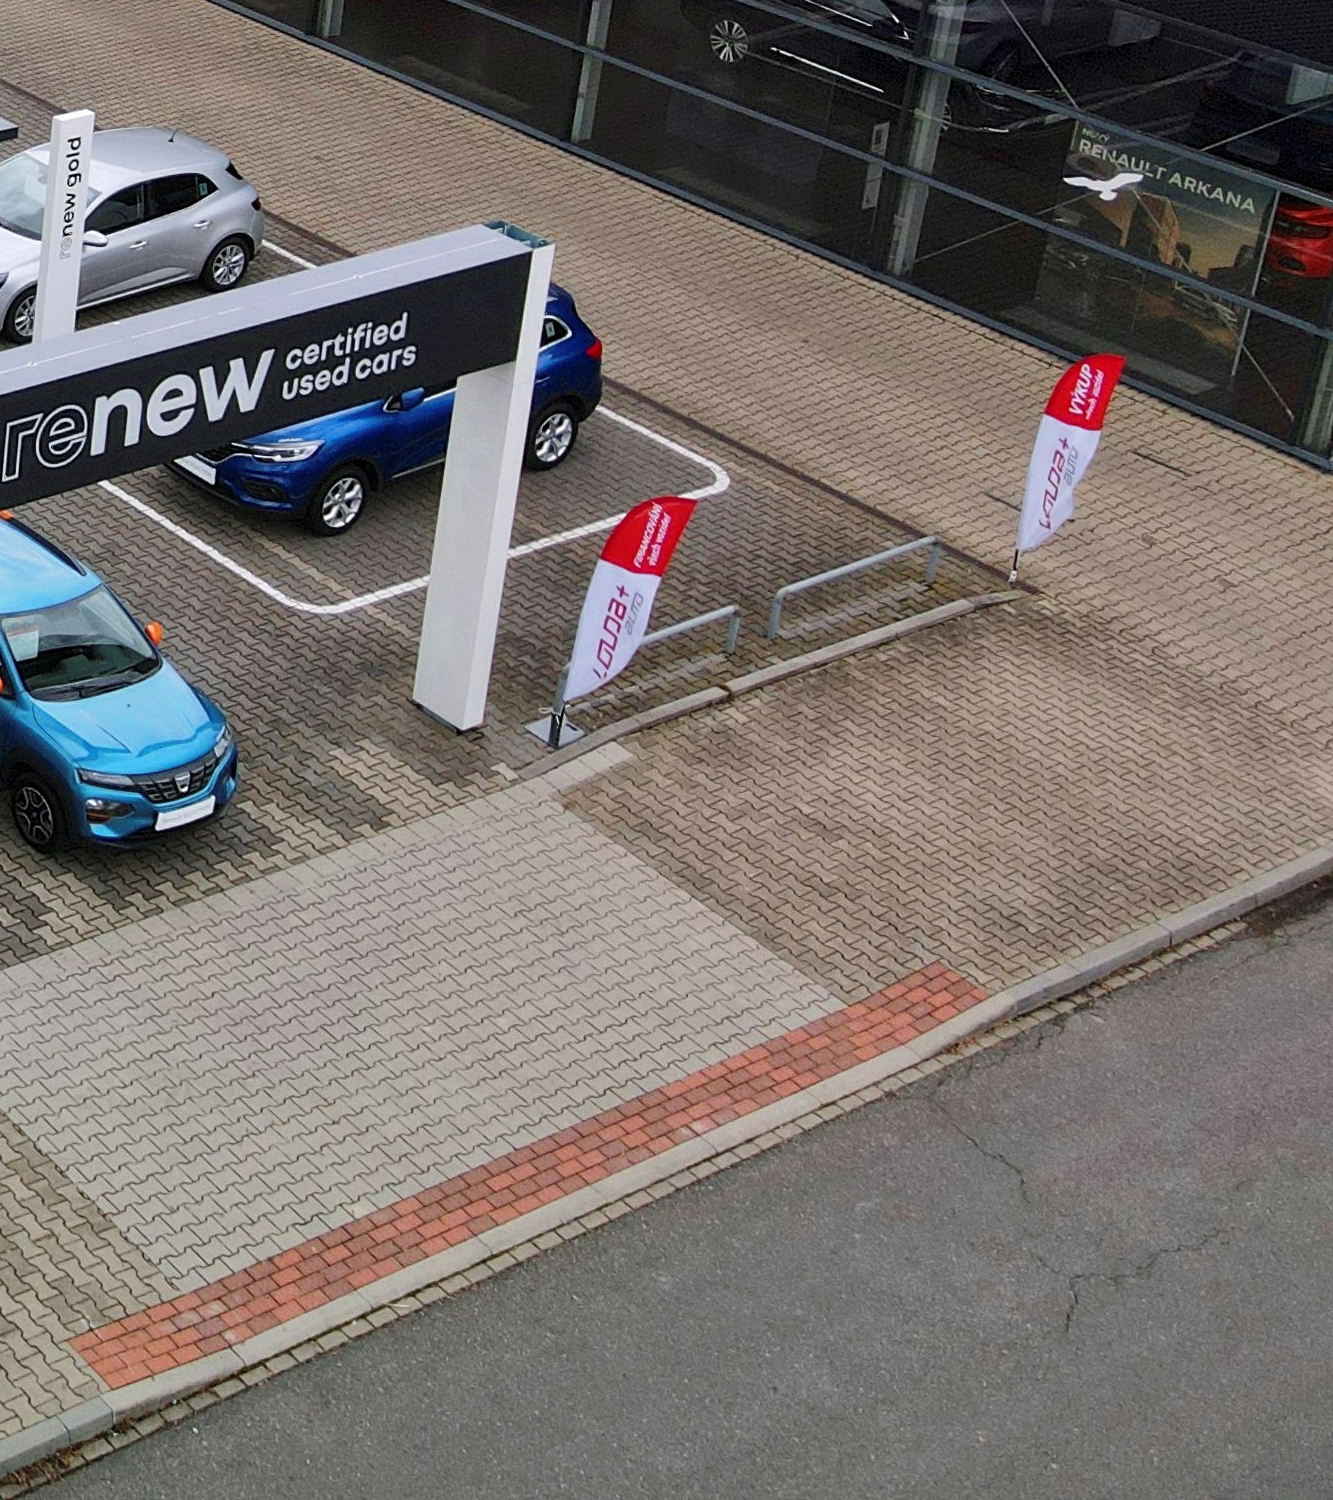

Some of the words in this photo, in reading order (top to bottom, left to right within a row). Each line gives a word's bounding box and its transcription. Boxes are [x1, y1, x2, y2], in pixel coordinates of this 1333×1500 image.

[66, 137, 82, 187] gold
[1079, 139, 1168, 180] RENAULT
[1168, 172, 1255, 215] ARKANA
[59, 193, 76, 260] renew
[285, 311, 409, 371] certified
[281, 358, 349, 400] used
[354, 344, 417, 381] cars
[1069, 363, 1092, 416] VÝKUP
[1, 348, 276, 483] renew
